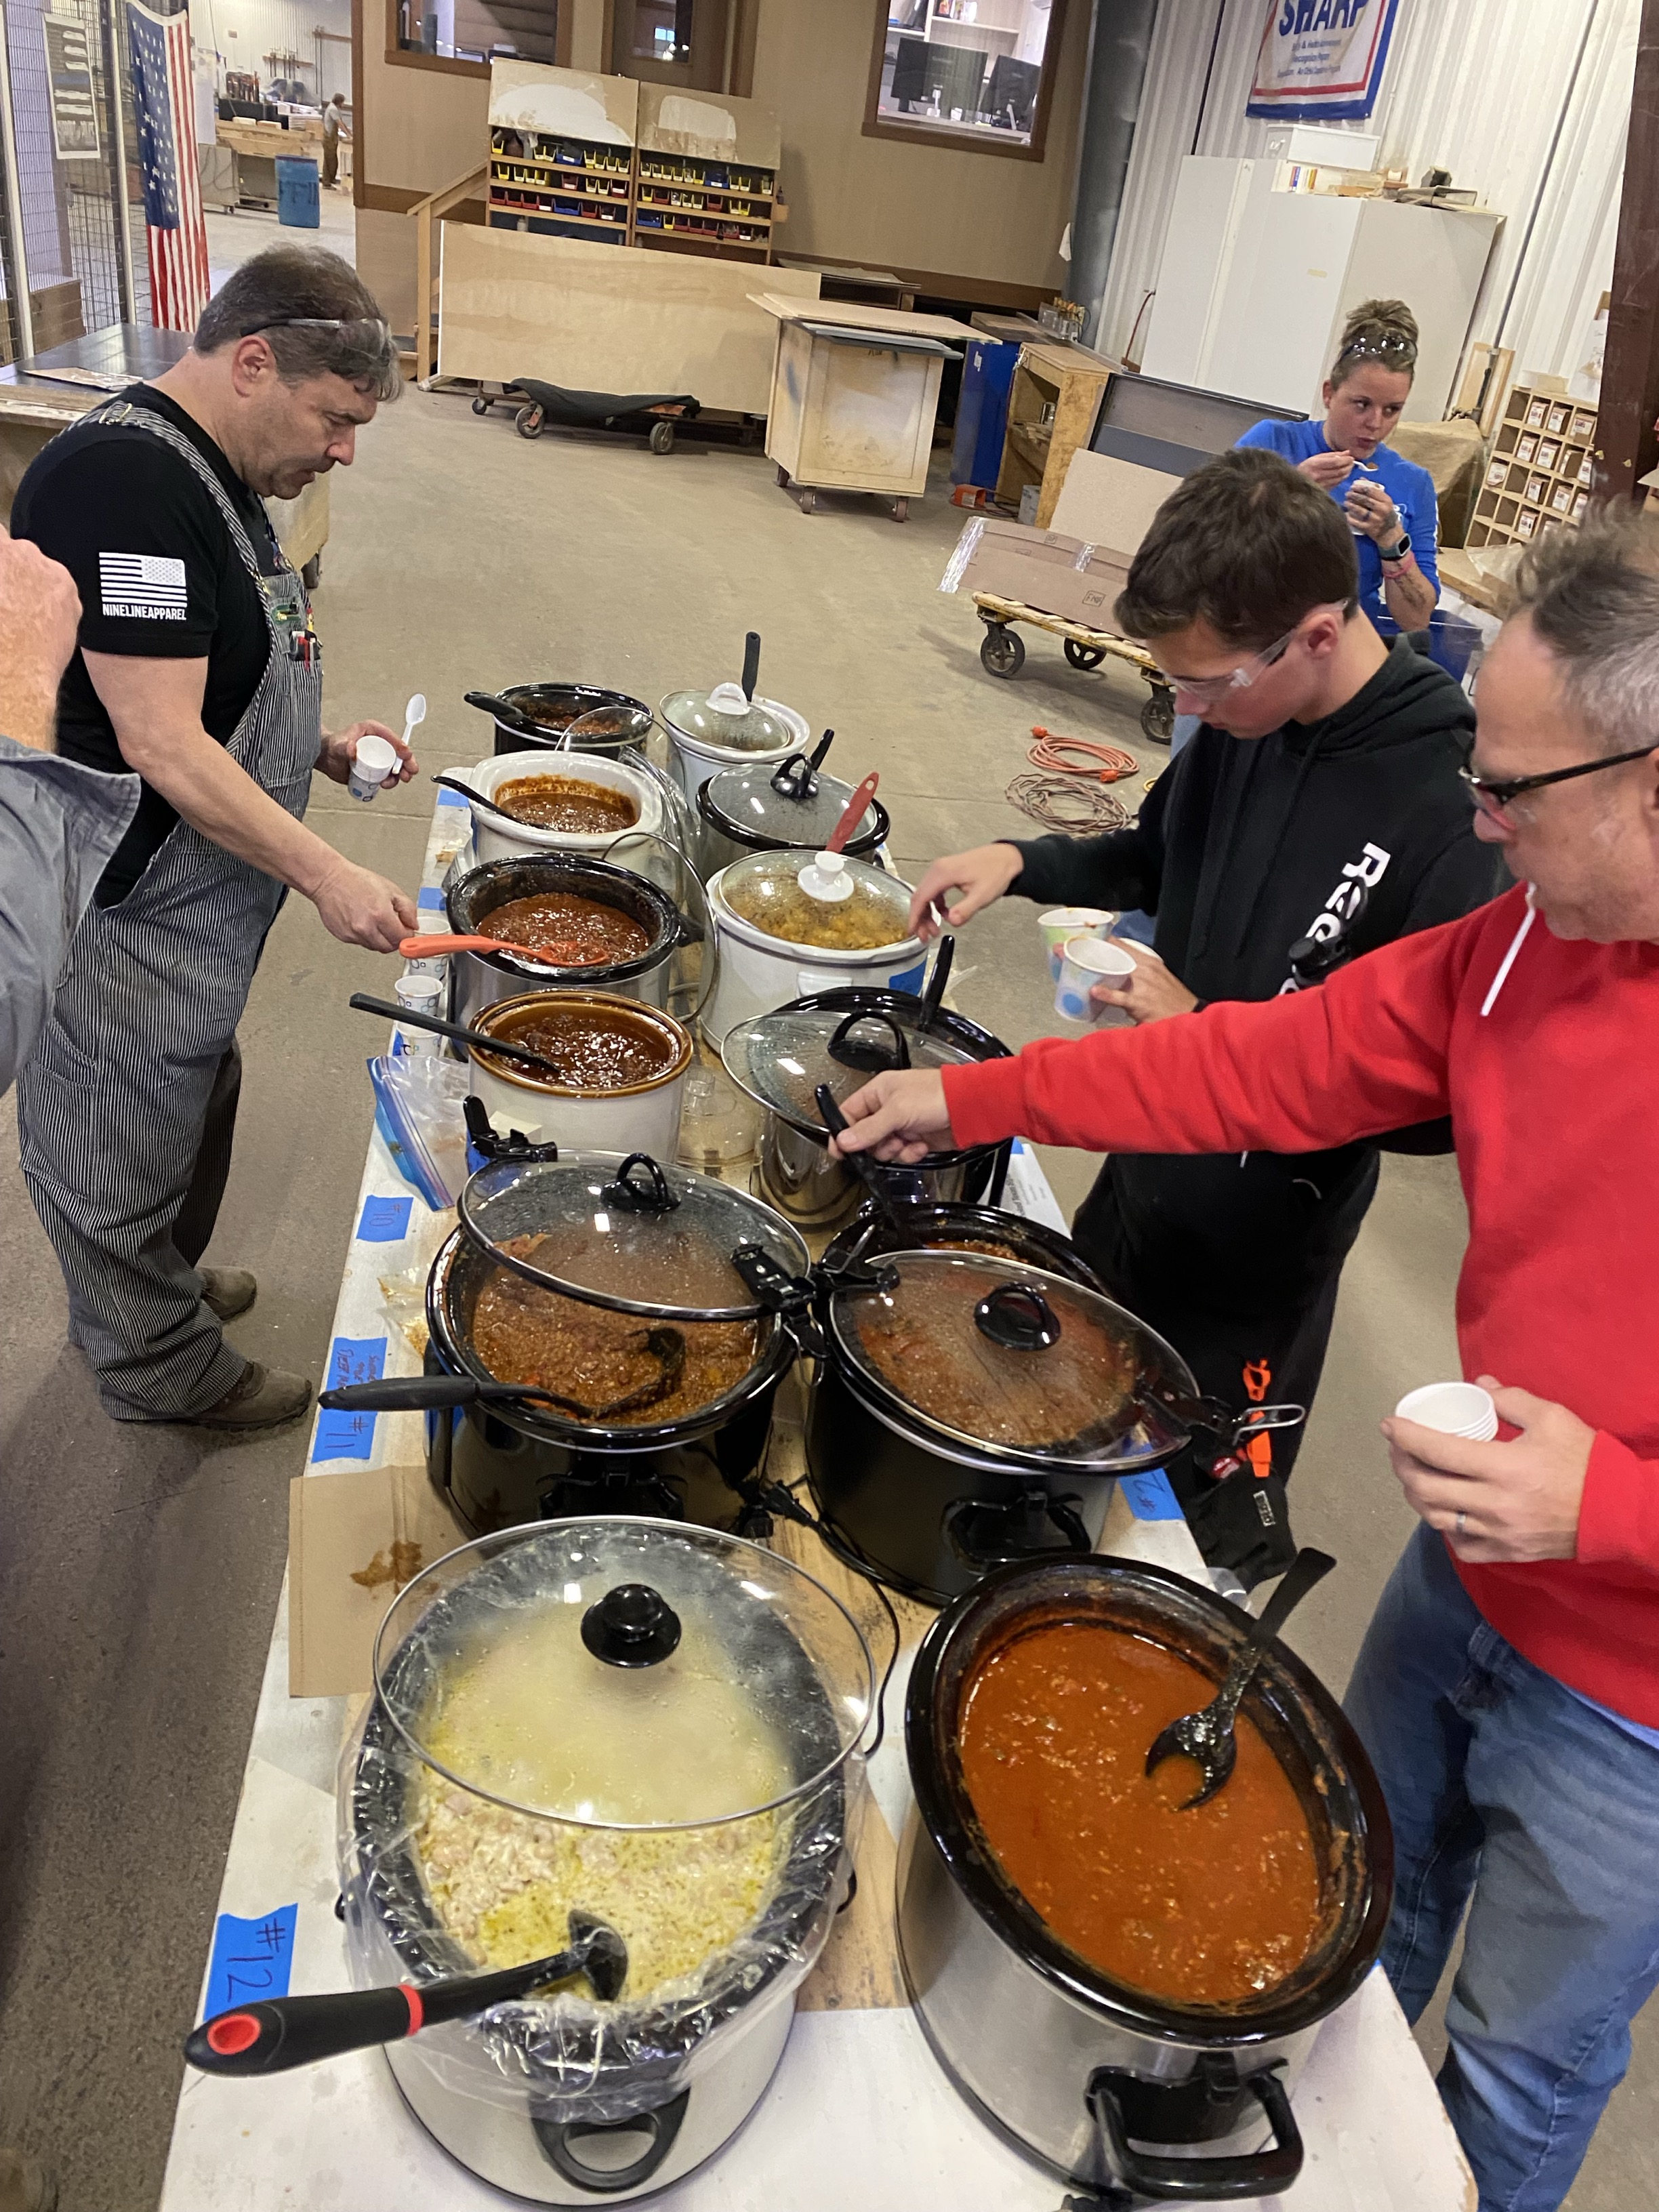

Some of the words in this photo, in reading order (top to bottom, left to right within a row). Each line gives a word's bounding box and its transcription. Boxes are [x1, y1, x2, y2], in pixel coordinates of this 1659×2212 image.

[369, 1202, 403, 1227] #10
[325, 1416, 369, 1449] #11
[1132, 1472, 1166, 1513] #2
[226, 1917, 286, 2003] #12
